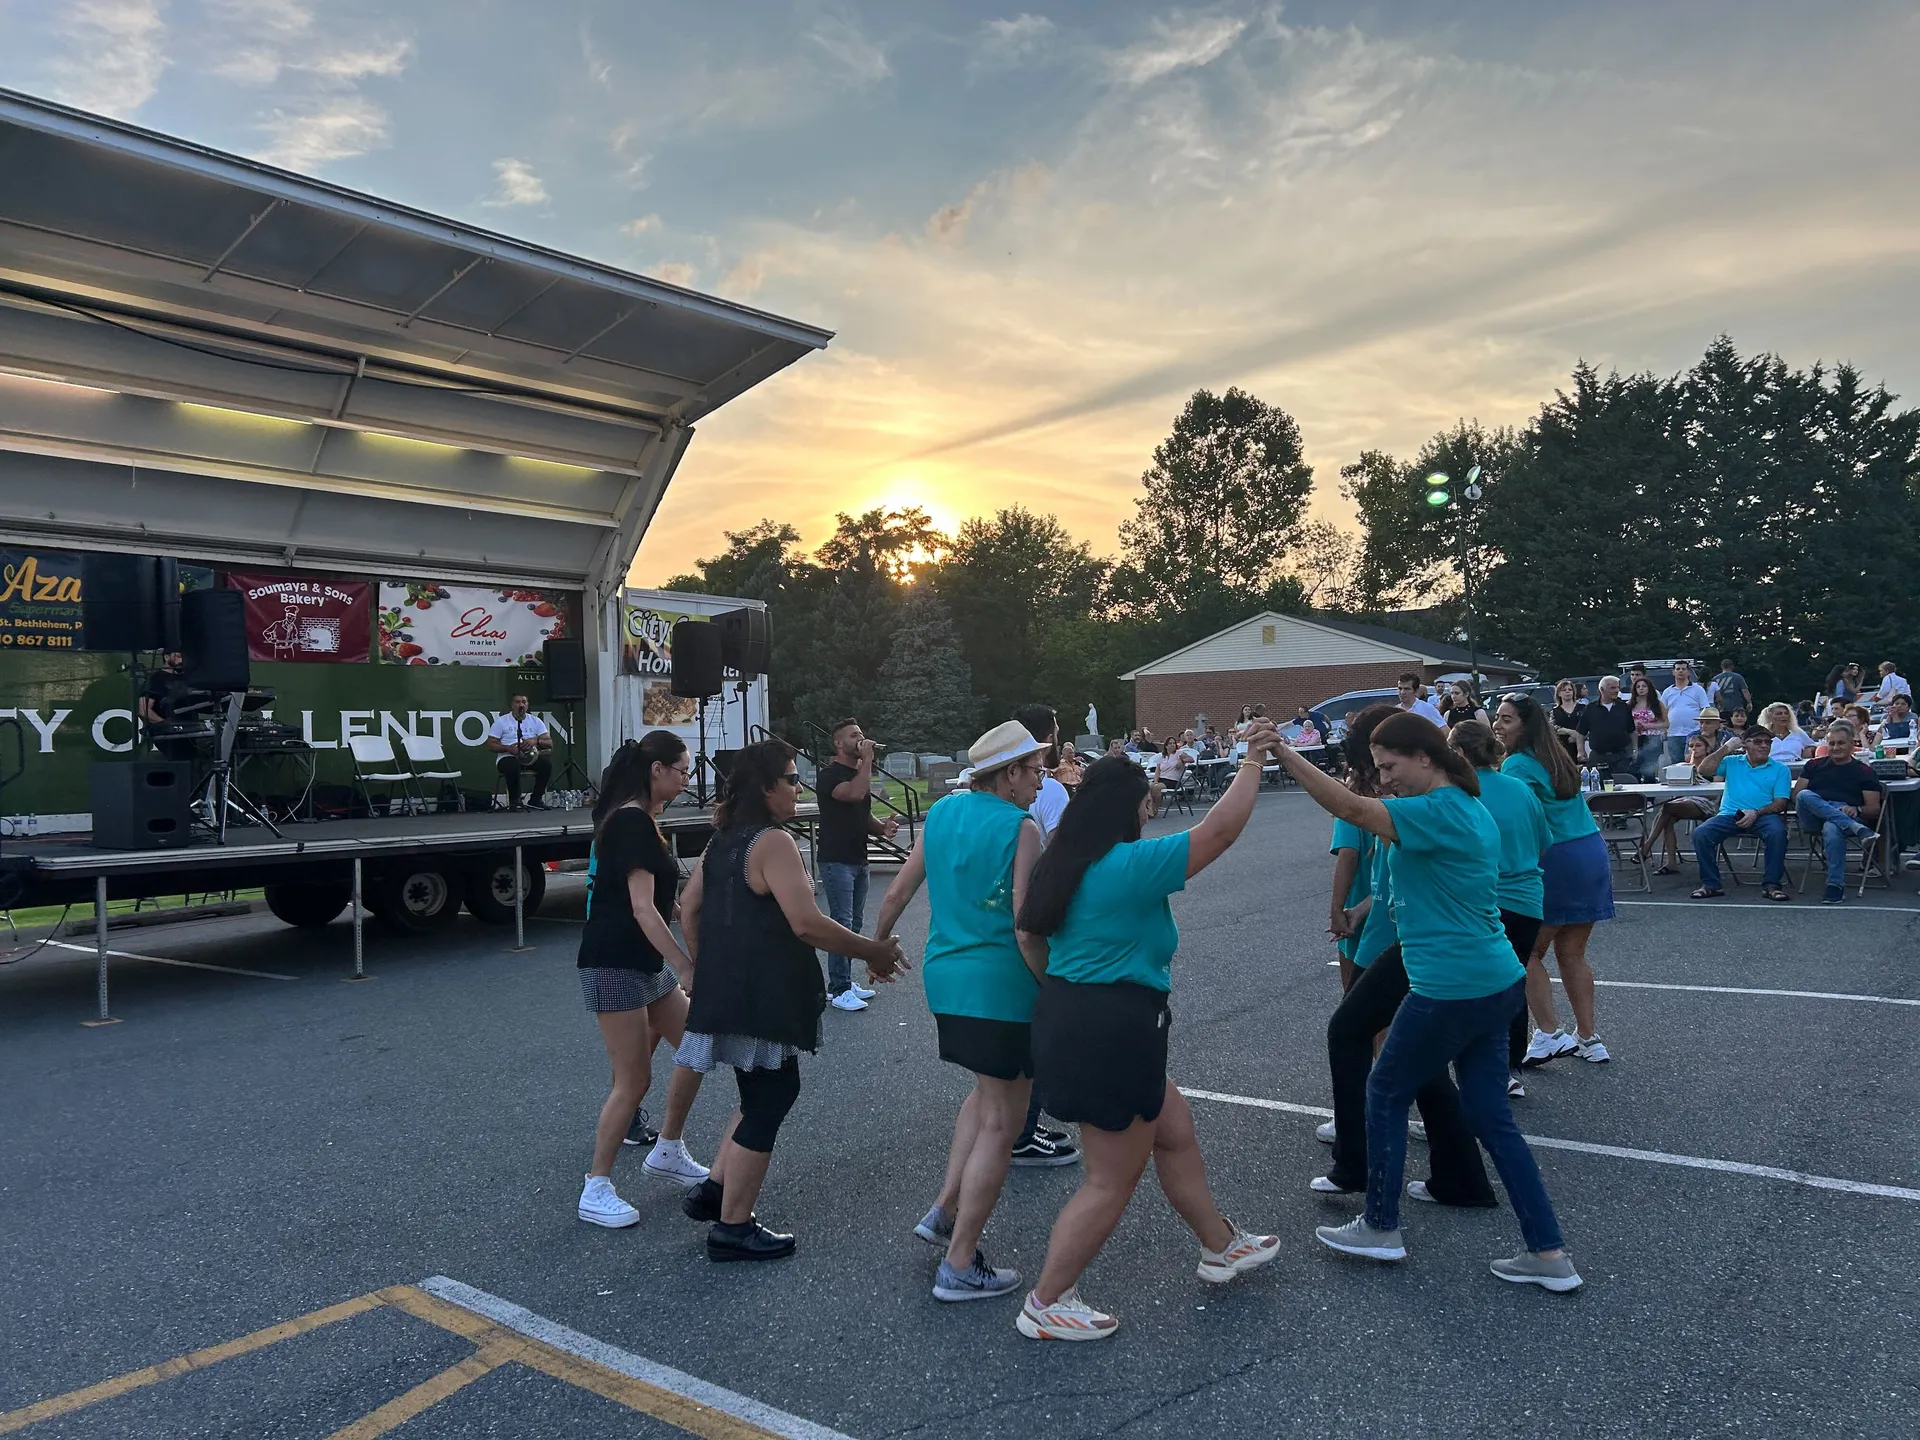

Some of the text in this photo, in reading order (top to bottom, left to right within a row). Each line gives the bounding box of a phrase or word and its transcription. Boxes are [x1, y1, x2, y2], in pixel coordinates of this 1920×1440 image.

[248, 582, 308, 600] Soumaya
[311, 583, 321, 593] &
[280, 593, 325, 607] Bakery
[14, 618, 73, 631] Bethlehem,
[450, 606, 508, 640] Elias
[628, 608, 671, 648] City
[17, 635, 44, 646] 867
[47, 636, 73, 647] 8111
[469, 639, 497, 647] market
